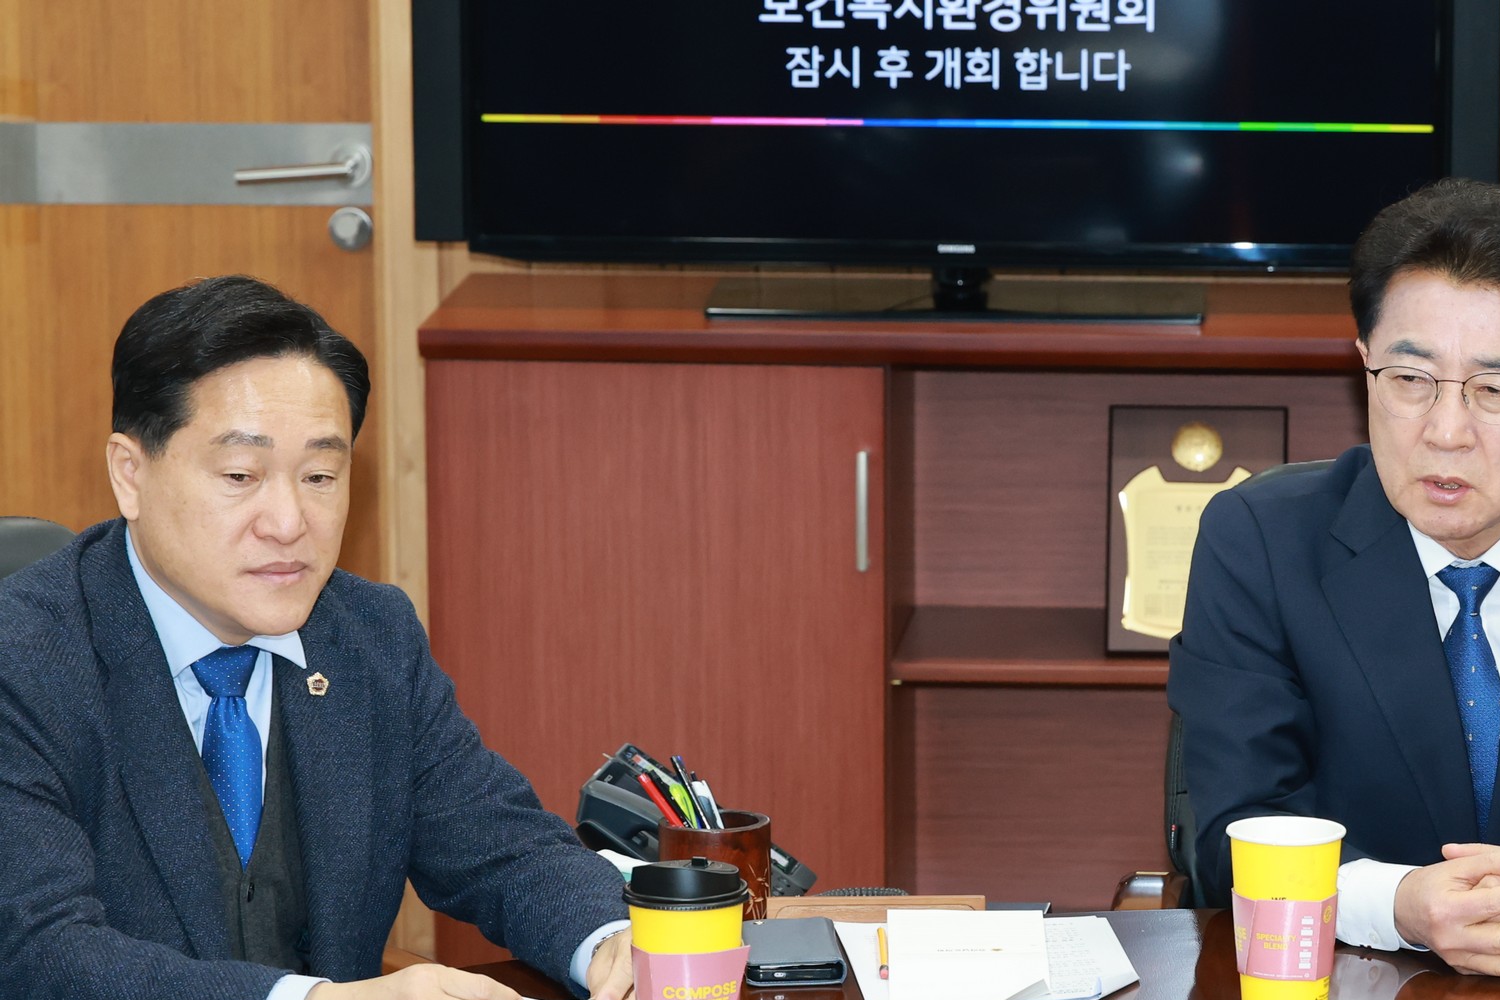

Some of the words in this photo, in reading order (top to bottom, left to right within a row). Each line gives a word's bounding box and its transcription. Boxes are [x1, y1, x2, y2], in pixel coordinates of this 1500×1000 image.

[785, 45, 860, 89] 잠시
[873, 45, 913, 89] 후
[924, 46, 1000, 91] 개회
[1013, 46, 1132, 92] 합니다
[662, 980, 737, 1000] COMPOSE
